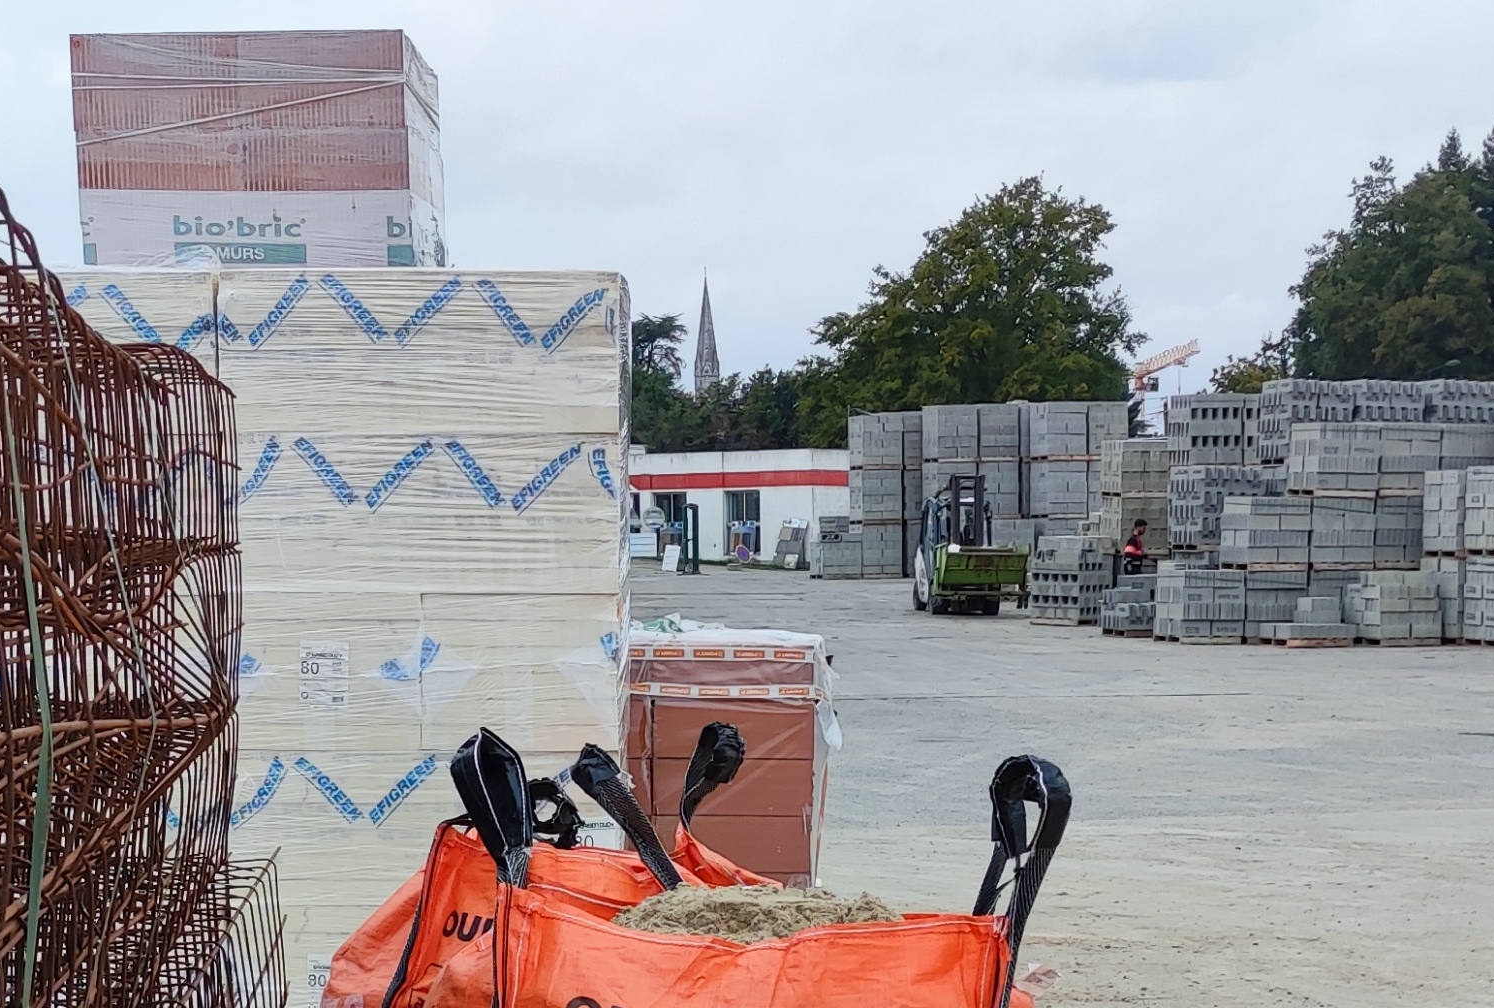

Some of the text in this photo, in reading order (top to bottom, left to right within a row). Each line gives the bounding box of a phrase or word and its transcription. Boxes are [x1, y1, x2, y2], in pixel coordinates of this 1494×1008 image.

[218, 247, 265, 261] MURS
[540, 288, 606, 349] EFIGREEN
[510, 443, 583, 512] EFIGREEN
[301, 661, 319, 674] 80
[231, 757, 285, 827] EFIGREEN
[294, 757, 362, 821] EFIGREEN
[368, 756, 437, 825] EFIGREEN
[308, 974, 327, 987] 80
